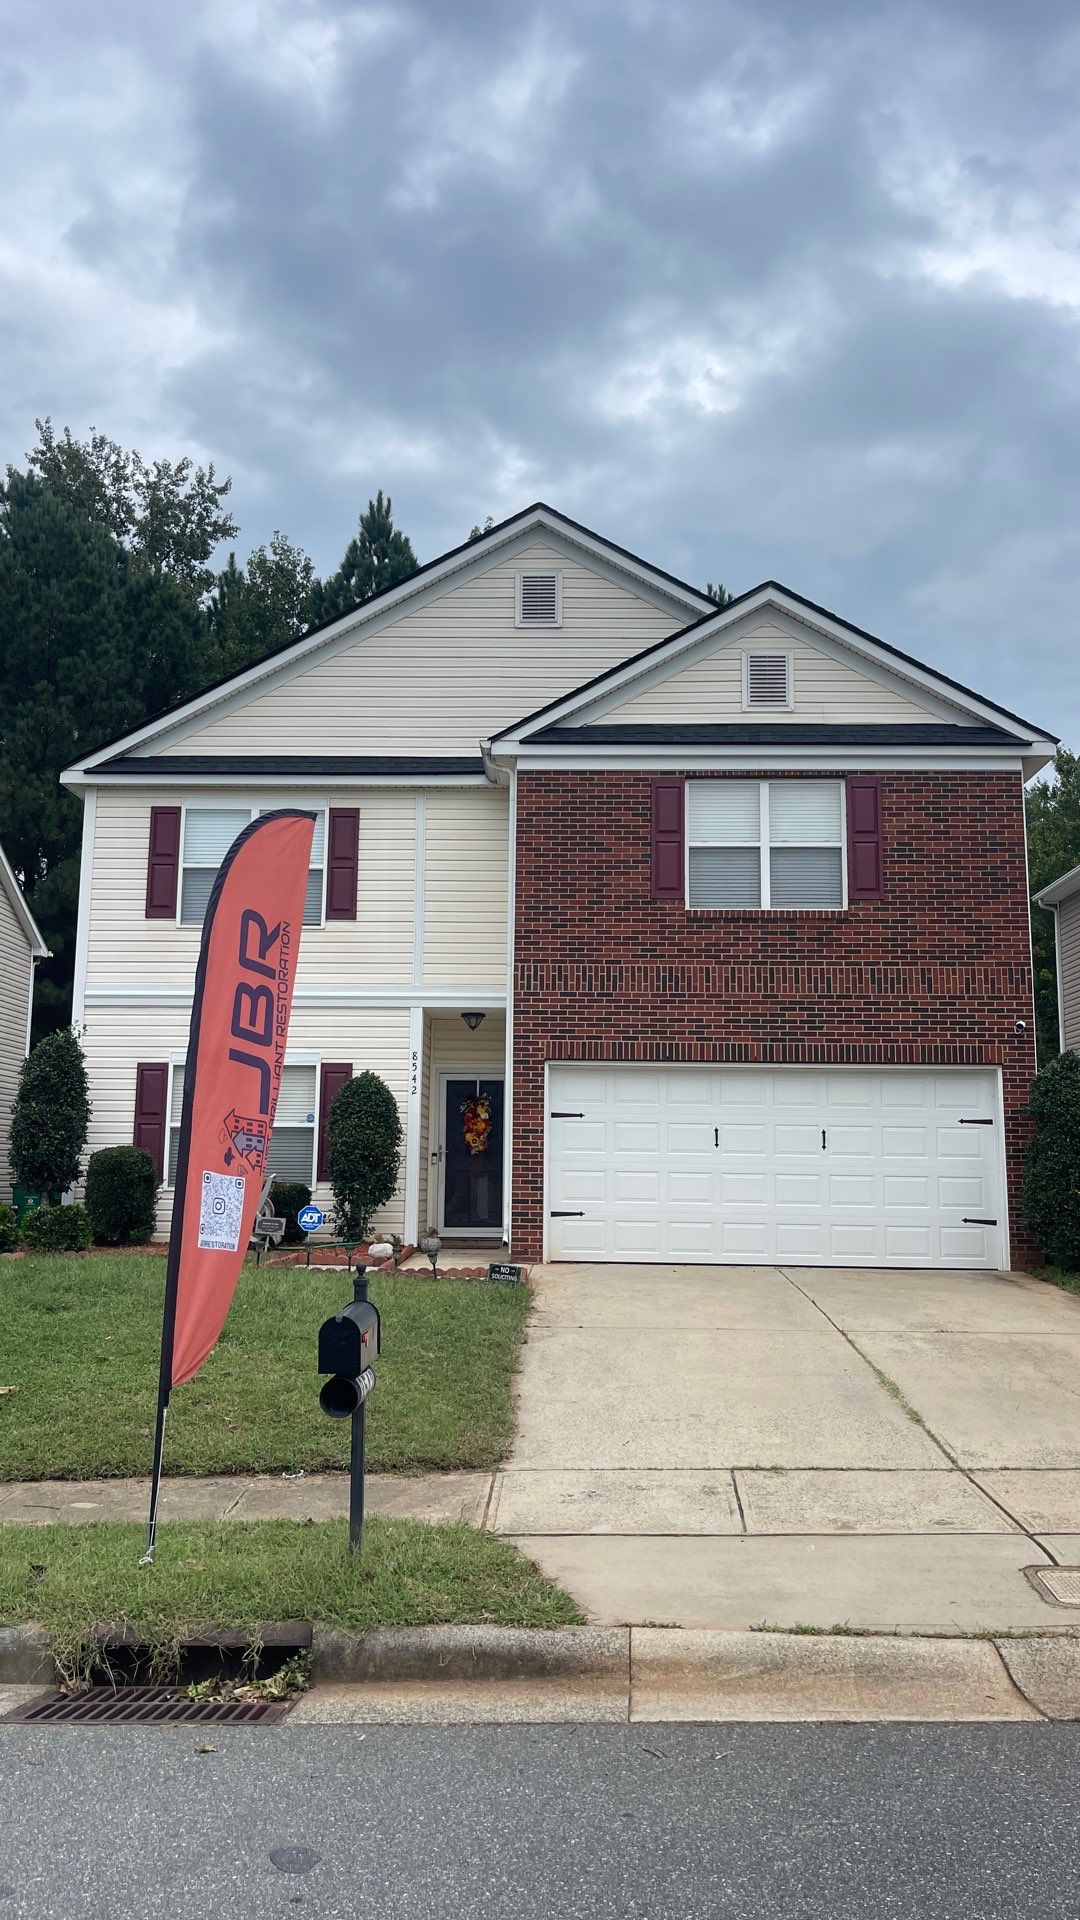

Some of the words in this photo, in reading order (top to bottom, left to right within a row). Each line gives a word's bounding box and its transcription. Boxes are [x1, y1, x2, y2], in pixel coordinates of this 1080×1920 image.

[228, 908, 281, 1115] JBR
[300, 1213, 320, 1223] ADT
[491, 1273, 518, 1282] SOLICITING
